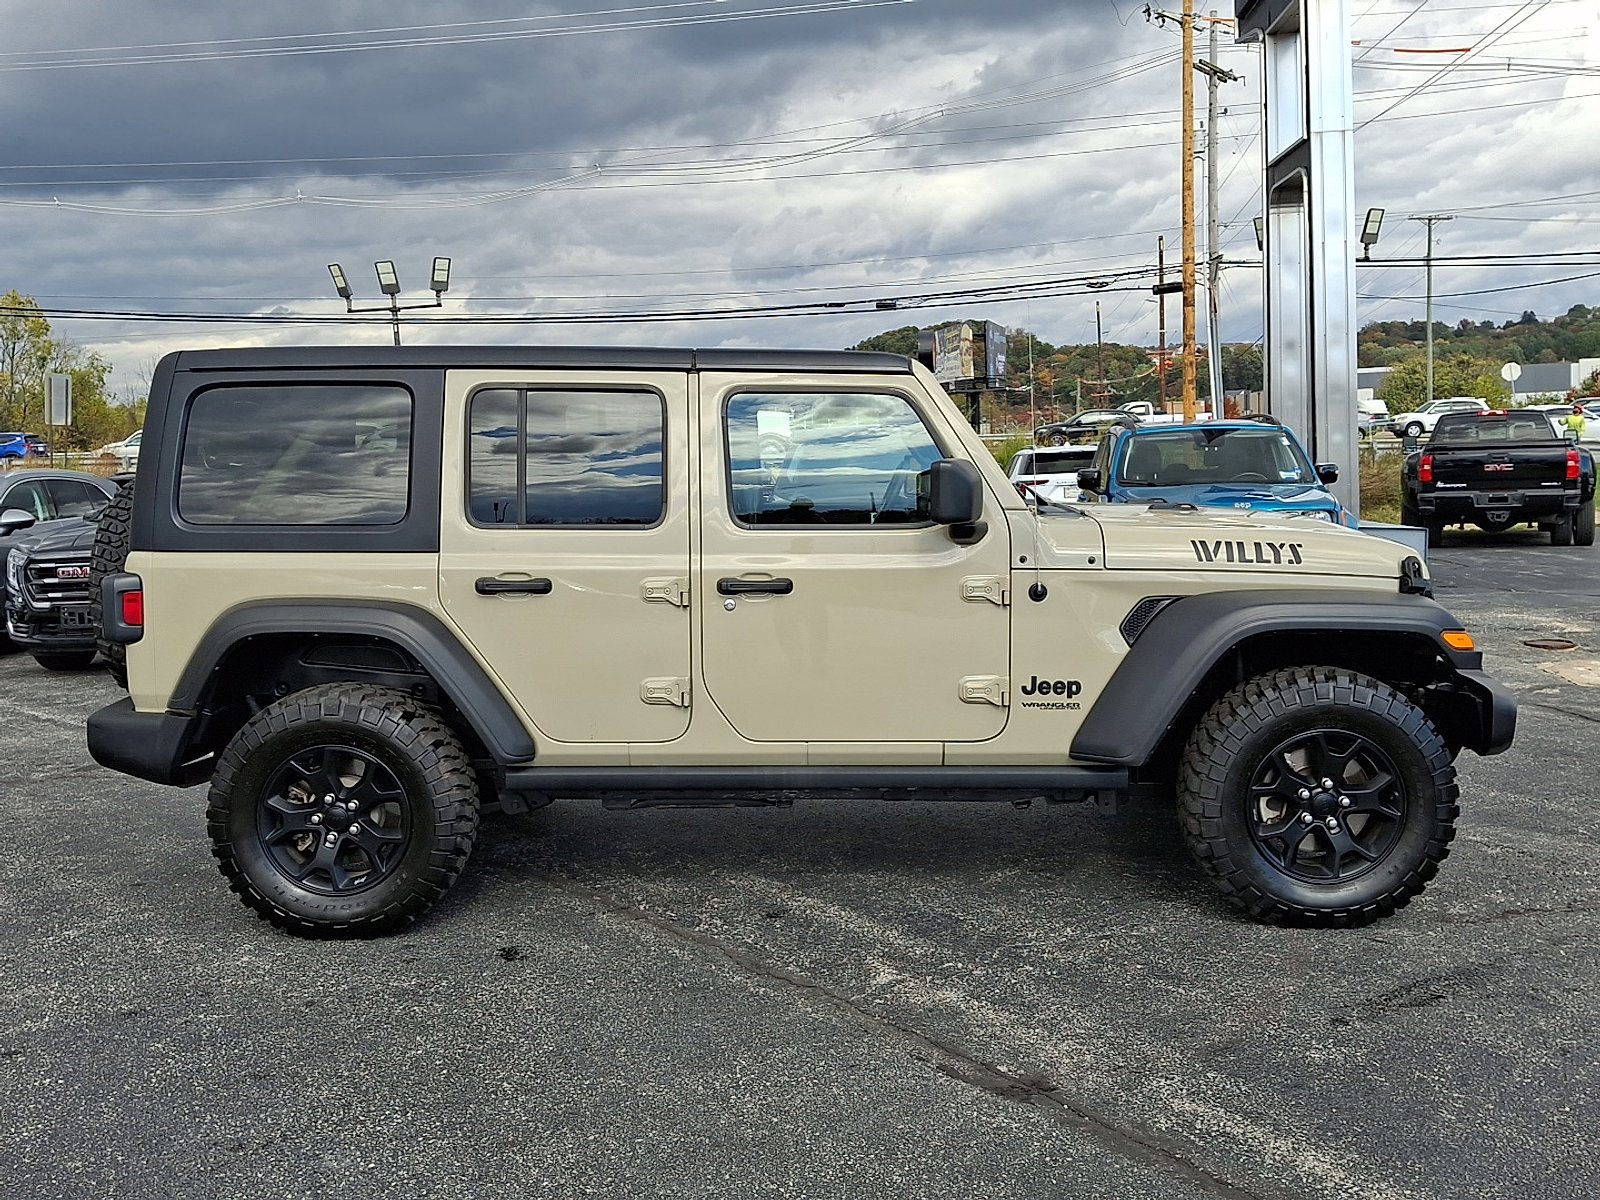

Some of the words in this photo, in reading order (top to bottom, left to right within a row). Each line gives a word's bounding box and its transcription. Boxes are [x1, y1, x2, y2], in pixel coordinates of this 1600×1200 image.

[1484, 463, 1514, 471] GMC
[1190, 540, 1303, 565] WILLYS
[57, 566, 90, 579] GM
[1021, 675, 1082, 699] Jeep
